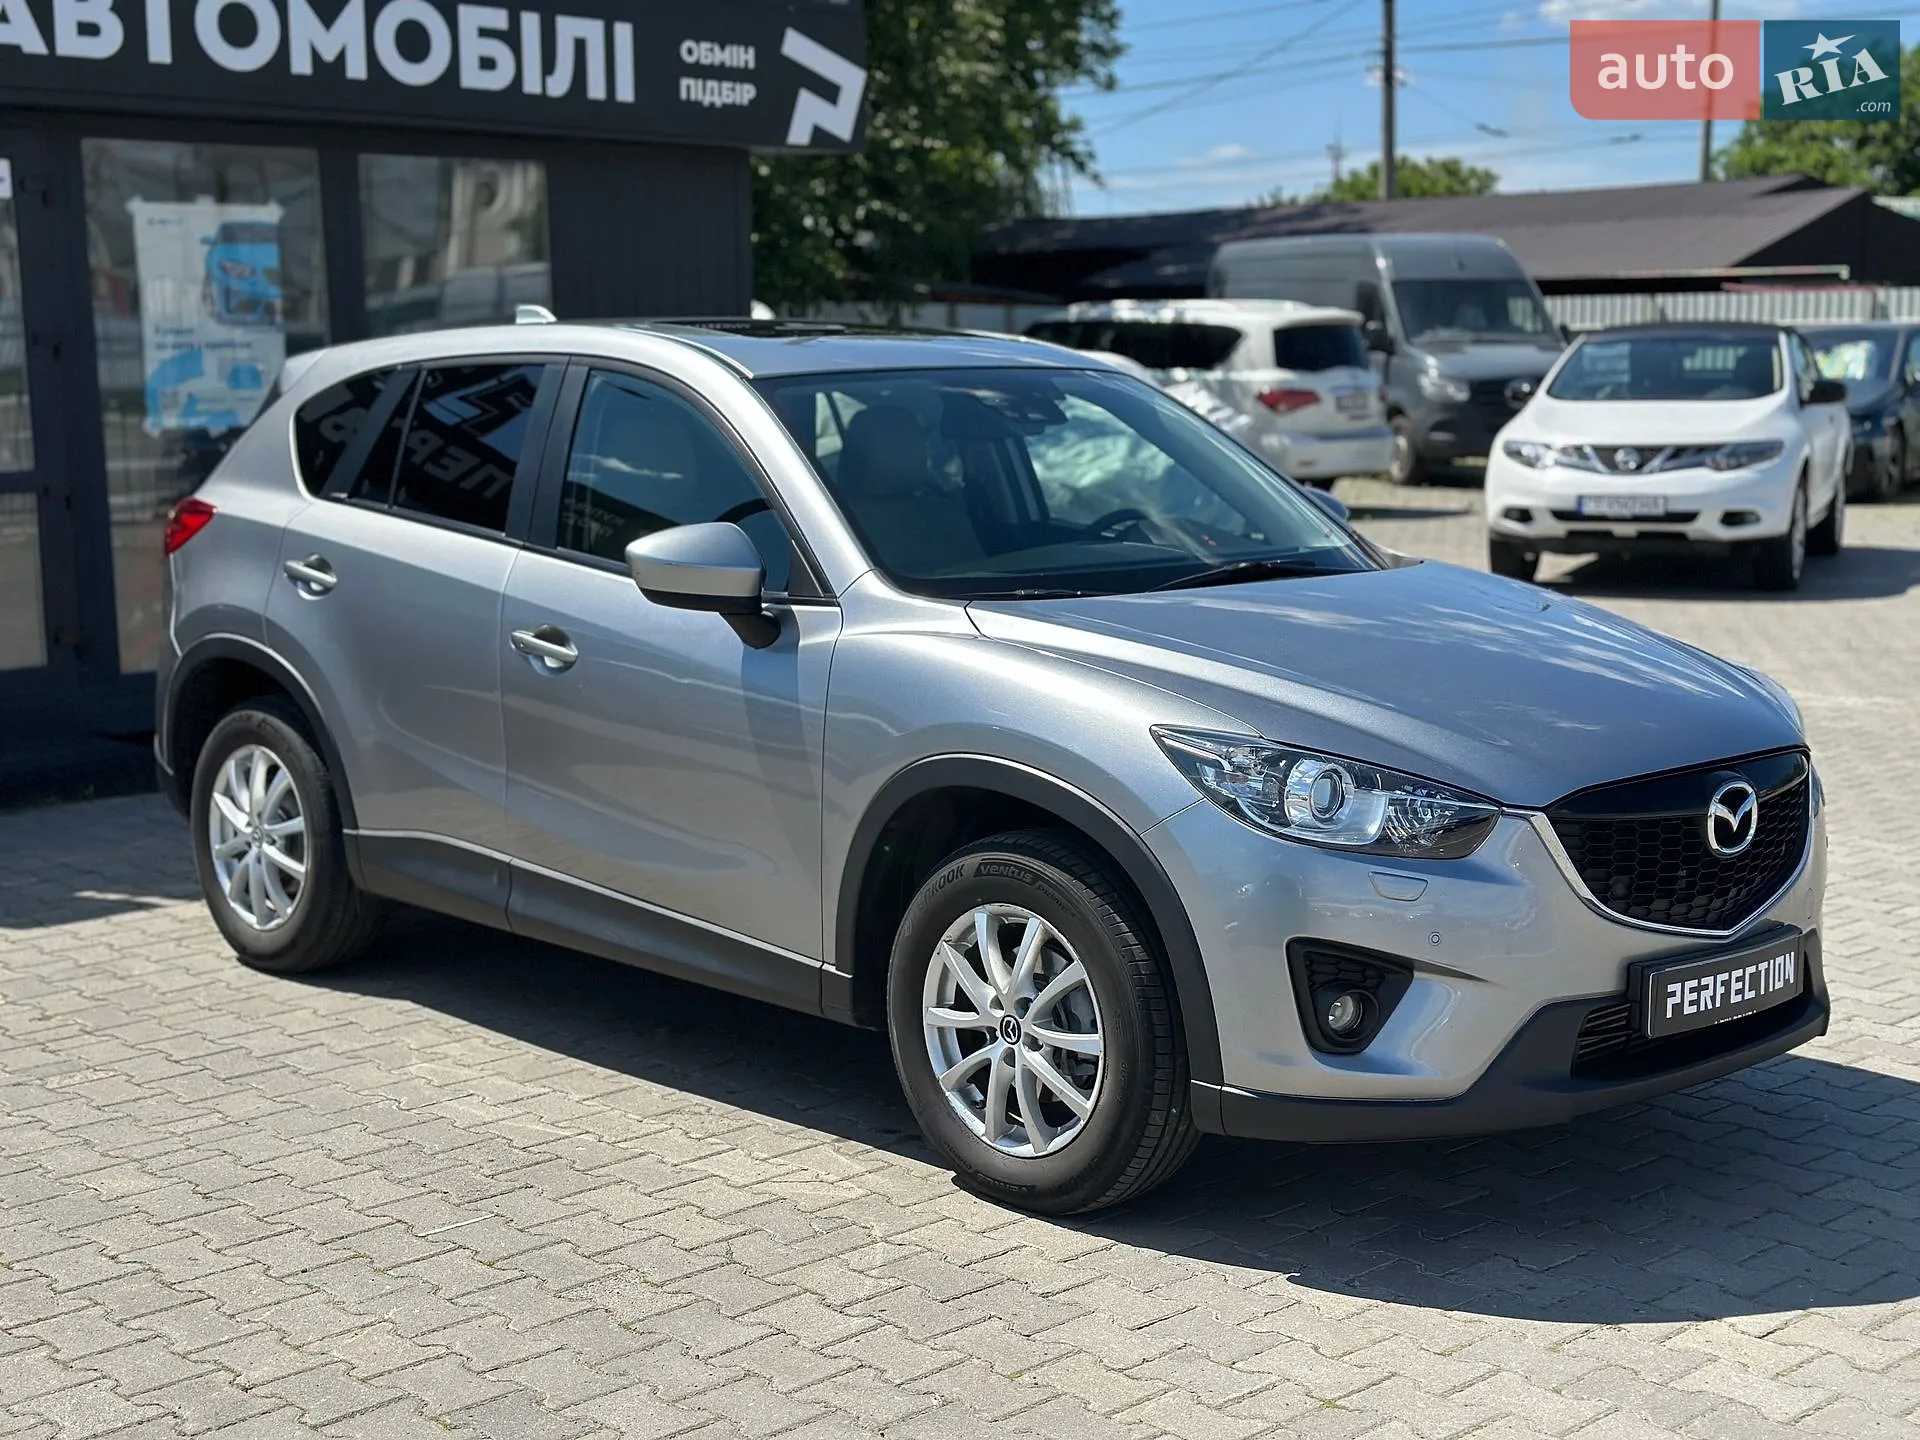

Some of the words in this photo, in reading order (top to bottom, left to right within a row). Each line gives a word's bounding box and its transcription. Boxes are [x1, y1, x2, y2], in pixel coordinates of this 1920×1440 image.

[679, 39, 756, 70] ОБМІН
[679, 77, 757, 106] ПІДБІР
[1666, 951, 1795, 1018] PERFECTION
